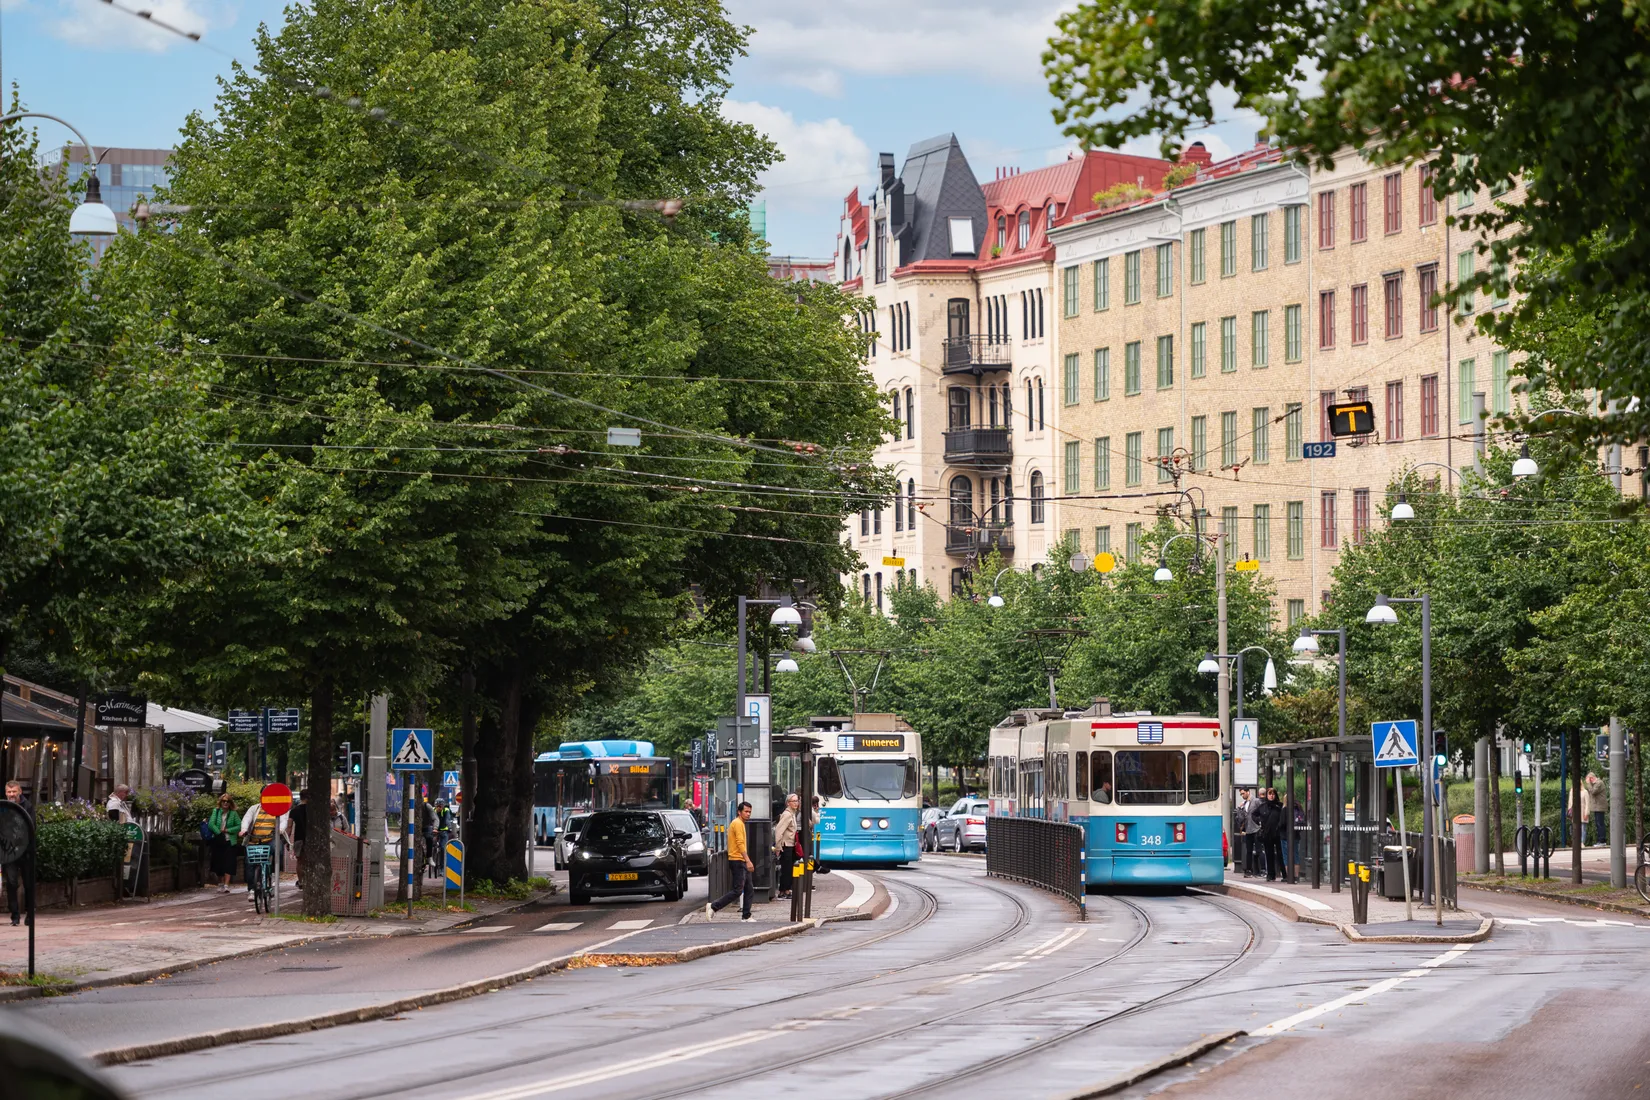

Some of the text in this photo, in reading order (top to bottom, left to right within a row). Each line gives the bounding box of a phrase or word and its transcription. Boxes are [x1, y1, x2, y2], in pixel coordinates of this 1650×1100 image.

[1335, 405, 1367, 432] T
[1305, 443, 1333, 457] 192
[1241, 724, 1251, 740] A
[824, 822, 836, 831] 316
[1140, 835, 1162, 846] 348
